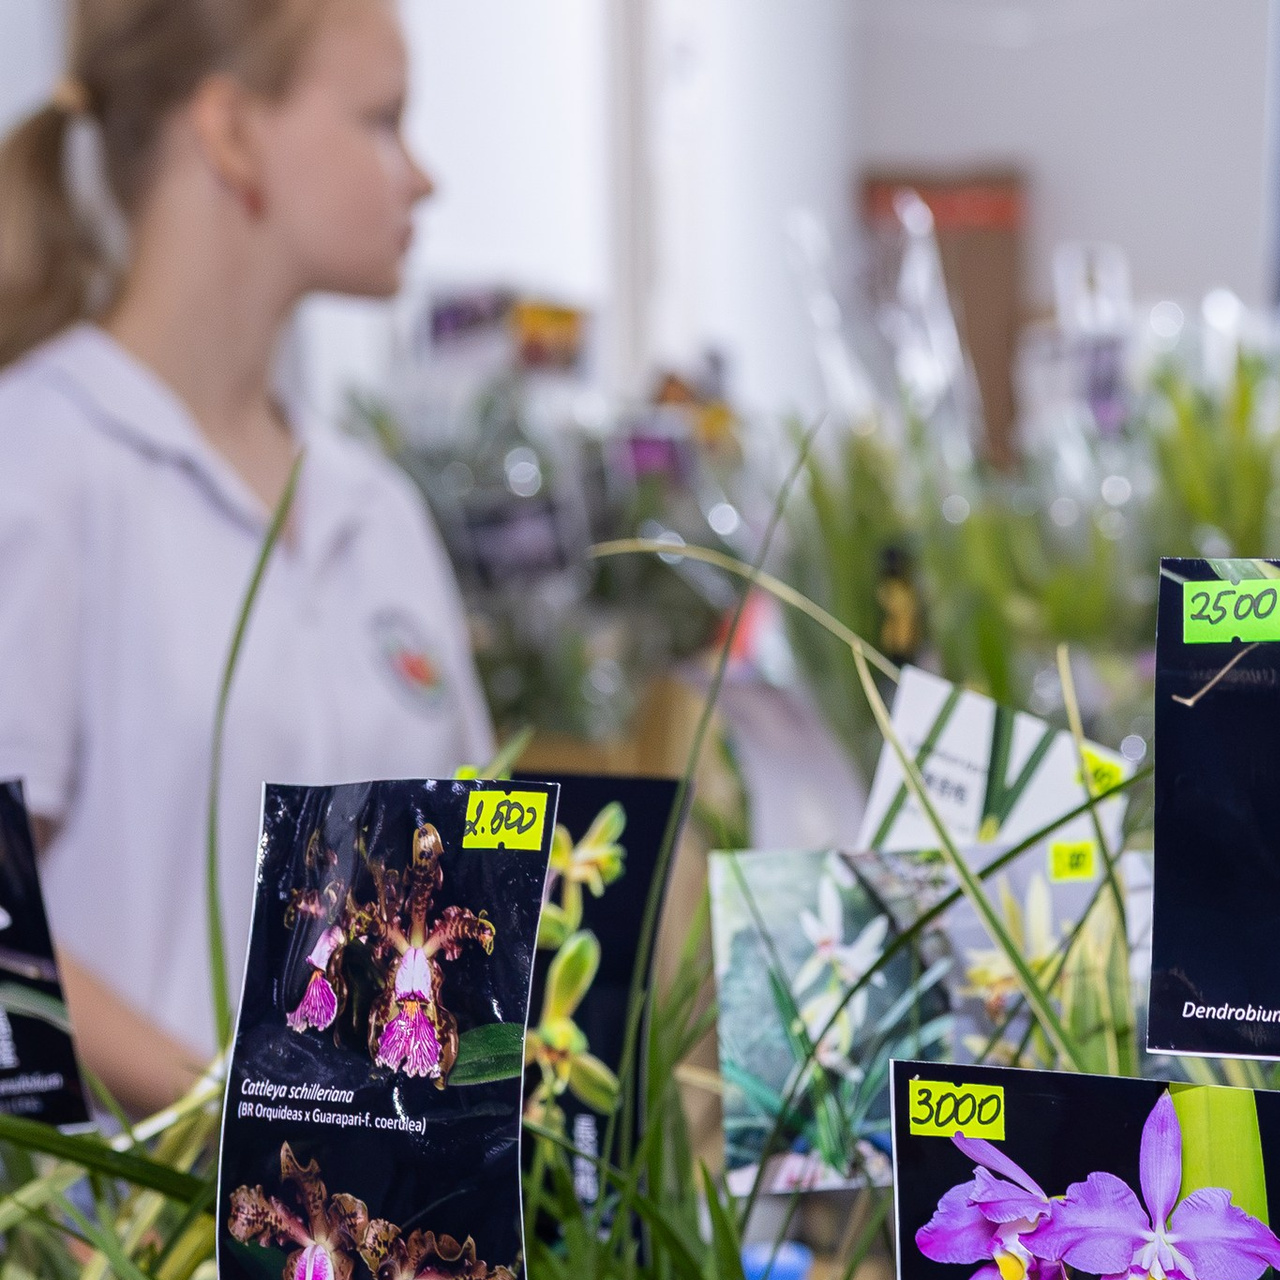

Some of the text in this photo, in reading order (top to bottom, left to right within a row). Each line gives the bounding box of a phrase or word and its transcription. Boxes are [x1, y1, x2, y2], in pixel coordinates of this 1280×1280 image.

[1190, 588, 1278, 625] 2500
[241, 1078, 354, 1104] Cattleya schilleriana
[911, 1088, 1002, 1128] 3000
[237, 1101, 254, 1119] (BR
[255, 1103, 303, 1122] Orquideas
[304, 1112, 311, 1122] x
[374, 1115, 427, 1135] coerulea)
